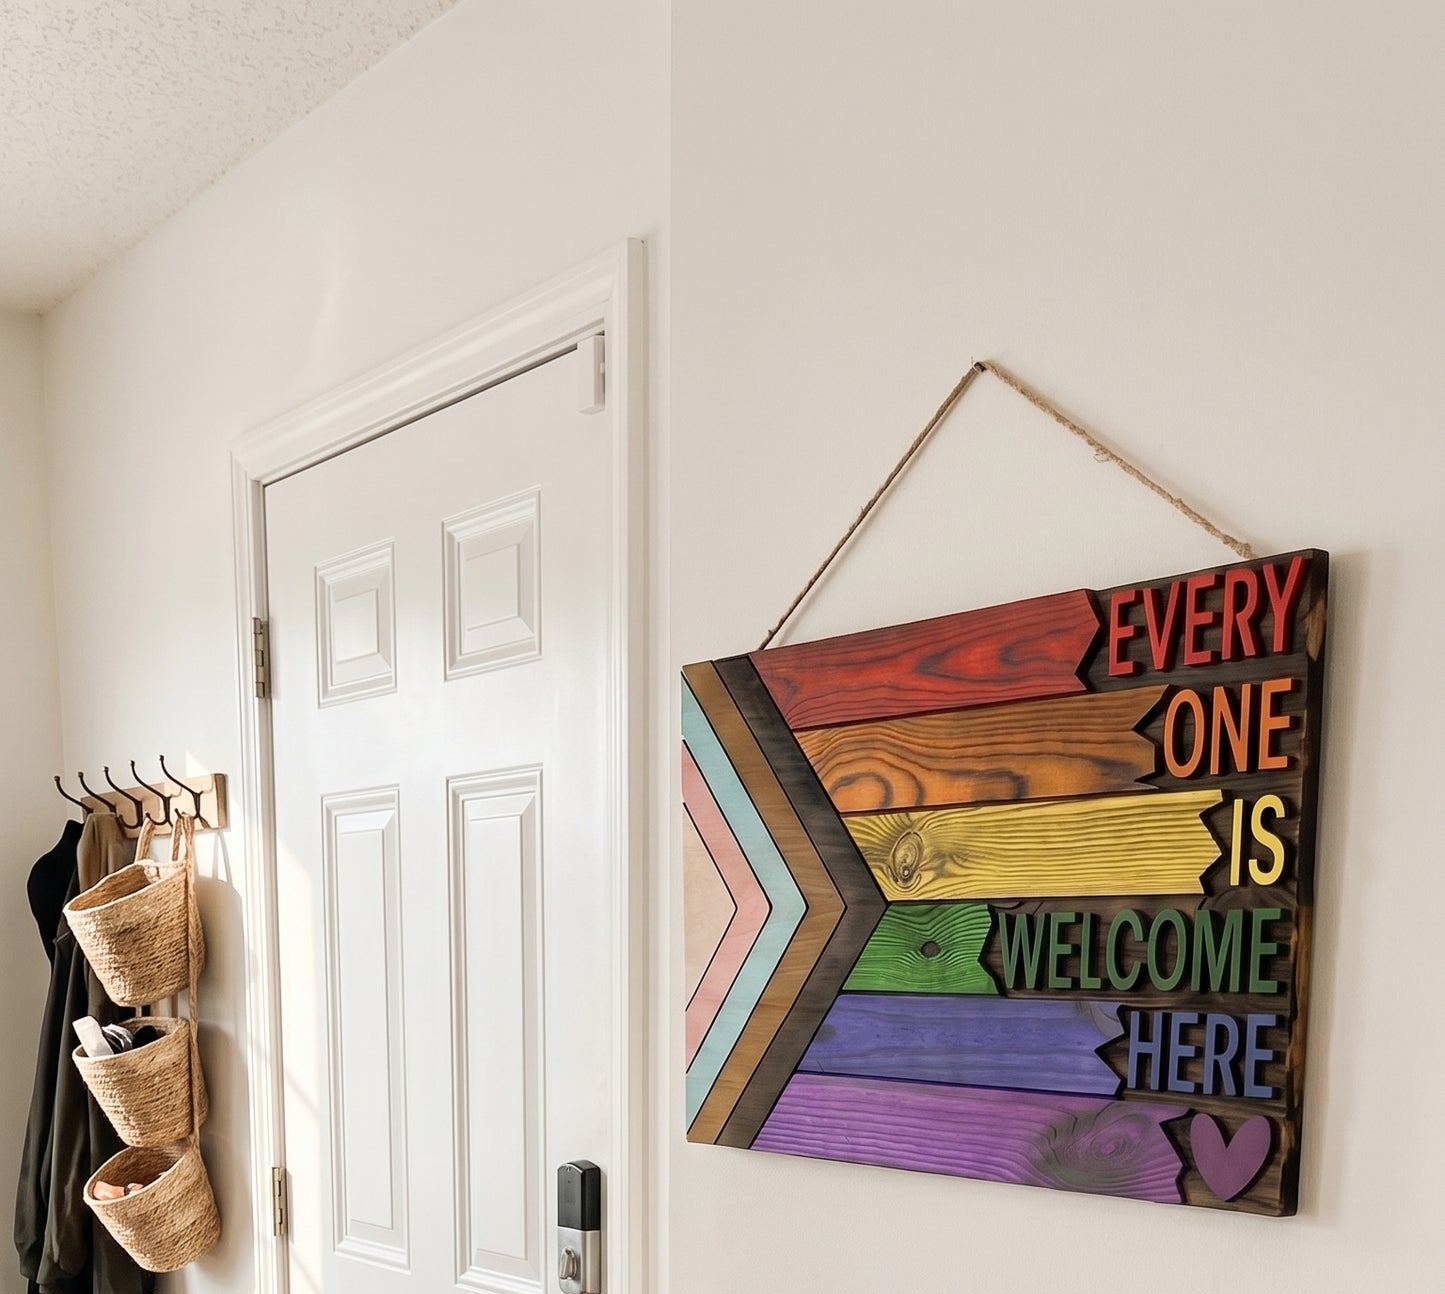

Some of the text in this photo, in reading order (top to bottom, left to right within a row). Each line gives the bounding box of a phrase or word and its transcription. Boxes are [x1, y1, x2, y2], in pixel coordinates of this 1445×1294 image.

[1108, 556, 1304, 676] EVERY
[1163, 678, 1292, 778] ONE
[1229, 794, 1286, 886] IS
[998, 907, 1282, 993] WELCOME
[1127, 1011, 1277, 1098] HERE
